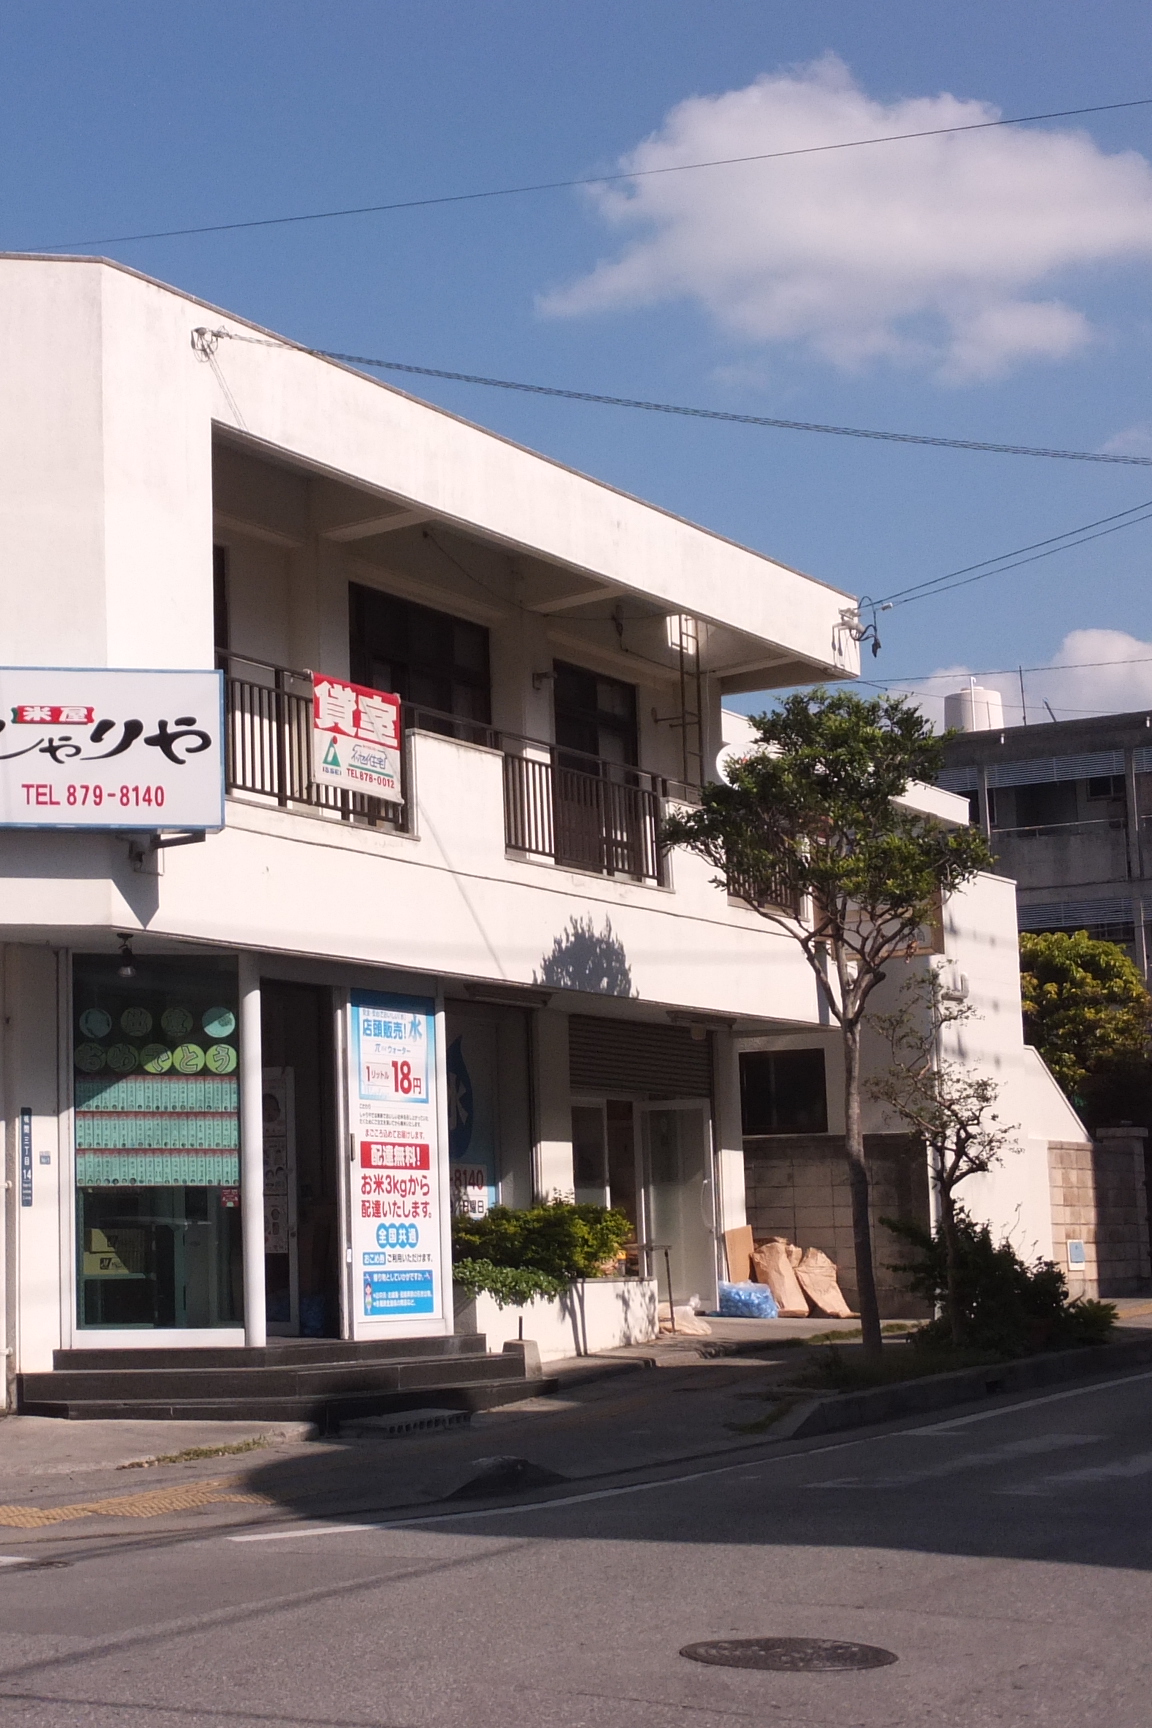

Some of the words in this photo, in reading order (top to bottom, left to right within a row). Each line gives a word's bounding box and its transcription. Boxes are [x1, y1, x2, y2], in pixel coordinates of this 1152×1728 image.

[22, 706, 88, 722] 米屋
[314, 681, 398, 747] 貸室
[346, 768, 359, 780] TEL
[21, 784, 61, 805] TEL
[66, 785, 165, 807] 879-8140
[22, 1169, 32, 1180] 14
[361, 1173, 431, 1198] お米3kgから
[361, 1200, 432, 1219] 配達いたします。
[378, 1228, 418, 1243] 全国共通
